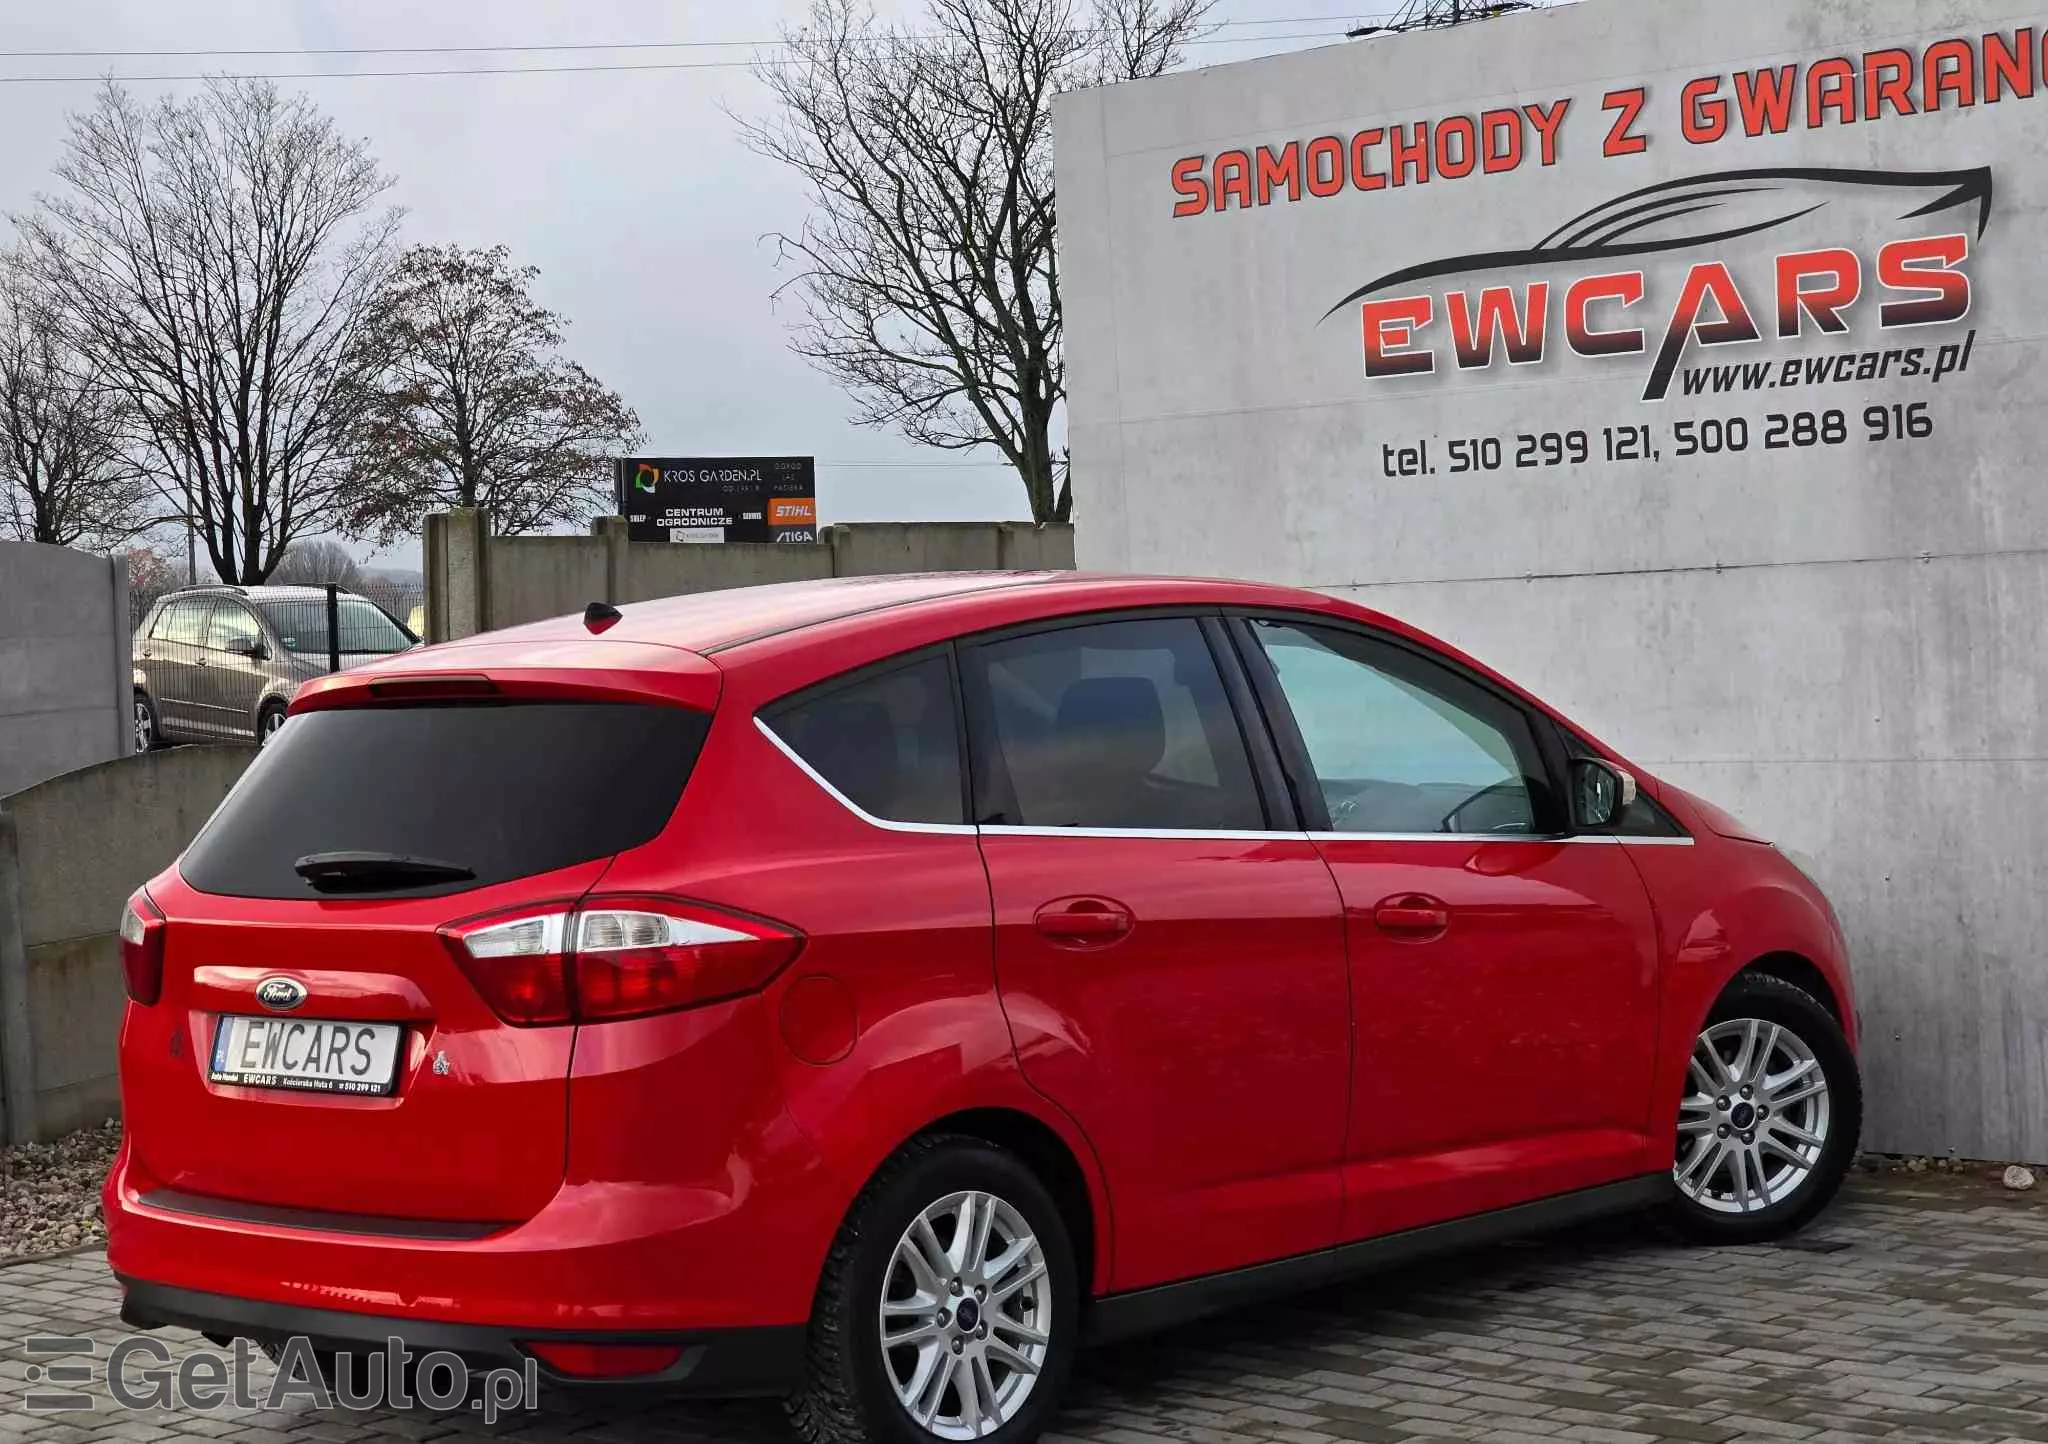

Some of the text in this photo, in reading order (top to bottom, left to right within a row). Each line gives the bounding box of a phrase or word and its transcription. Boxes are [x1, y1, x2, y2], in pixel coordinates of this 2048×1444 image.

[1171, 27, 2048, 218] SAMOCHODY Z GWARAN
[1362, 234, 1970, 401] EWCARS
[1683, 330, 1976, 395] www.ewcars.pl
[1383, 402, 1932, 477] tel. 510 299 121, 500 288 916
[663, 468, 762, 483] KROS GARDEN.PL
[665, 507, 723, 517] CENTRUM
[775, 504, 812, 517] STIHL
[262, 982, 293, 1001] Ford
[240, 1018, 376, 1077] EWCARS
[243, 1073, 277, 1086] EWCARS
